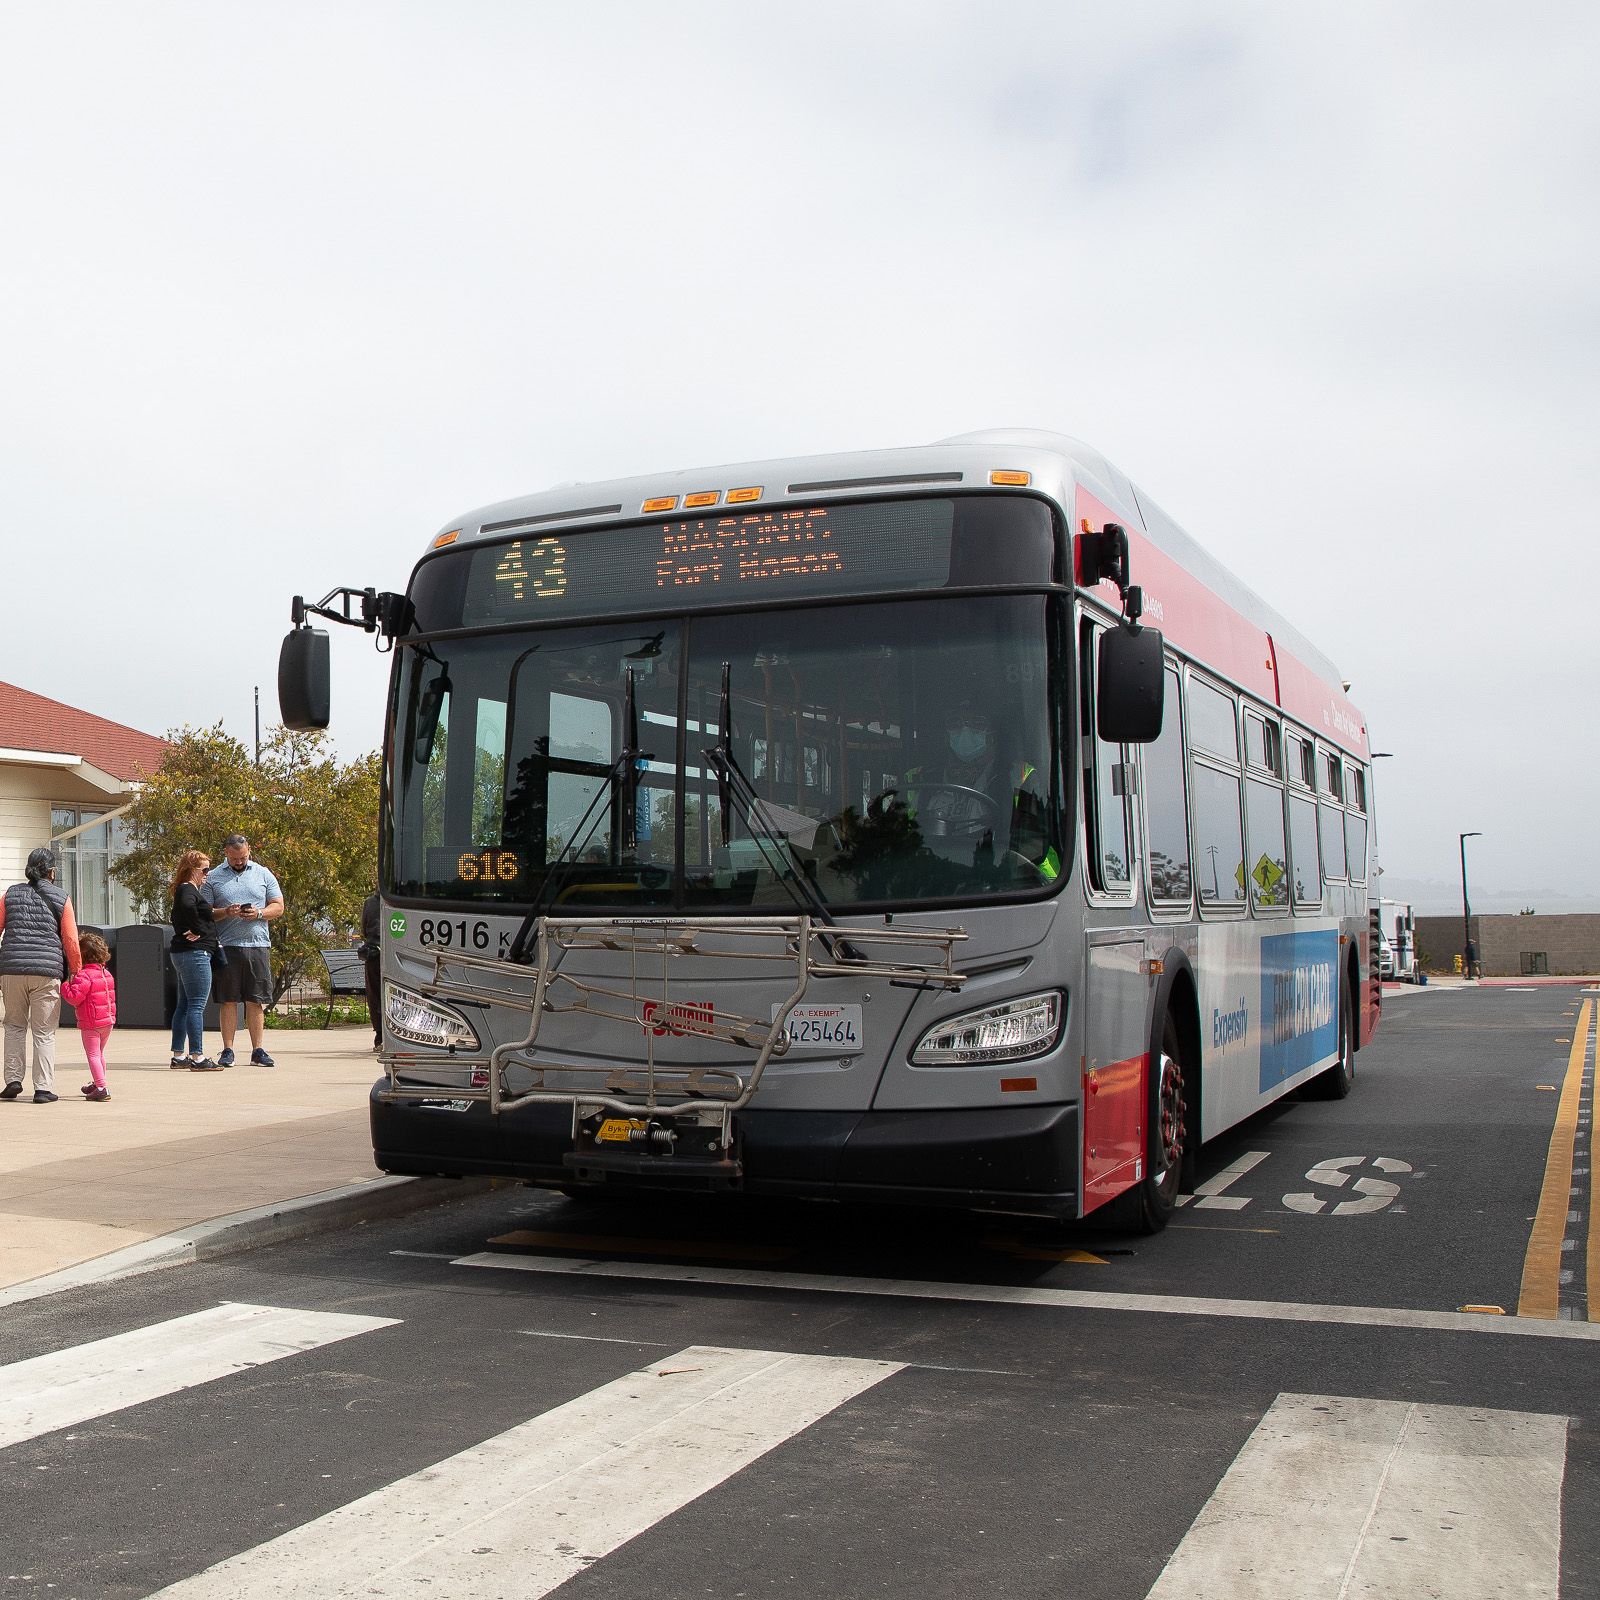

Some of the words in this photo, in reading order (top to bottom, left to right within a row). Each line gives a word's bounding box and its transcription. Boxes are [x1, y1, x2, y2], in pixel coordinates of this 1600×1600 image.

[495, 538, 567, 599] 43
[457, 852, 518, 881] 616
[390, 919, 406, 932] GZ
[419, 919, 490, 950] 8916
[500, 931, 511, 947] K
[793, 1010, 807, 1018] CA
[808, 1009, 840, 1018] EXEMPT
[1273, 969, 1294, 1047] FREE
[1295, 966, 1311, 1038] CPA
[779, 1020, 857, 1043] 425464
[1213, 996, 1248, 1056] Expensify
[608, 1125, 632, 1134] Byk-R
